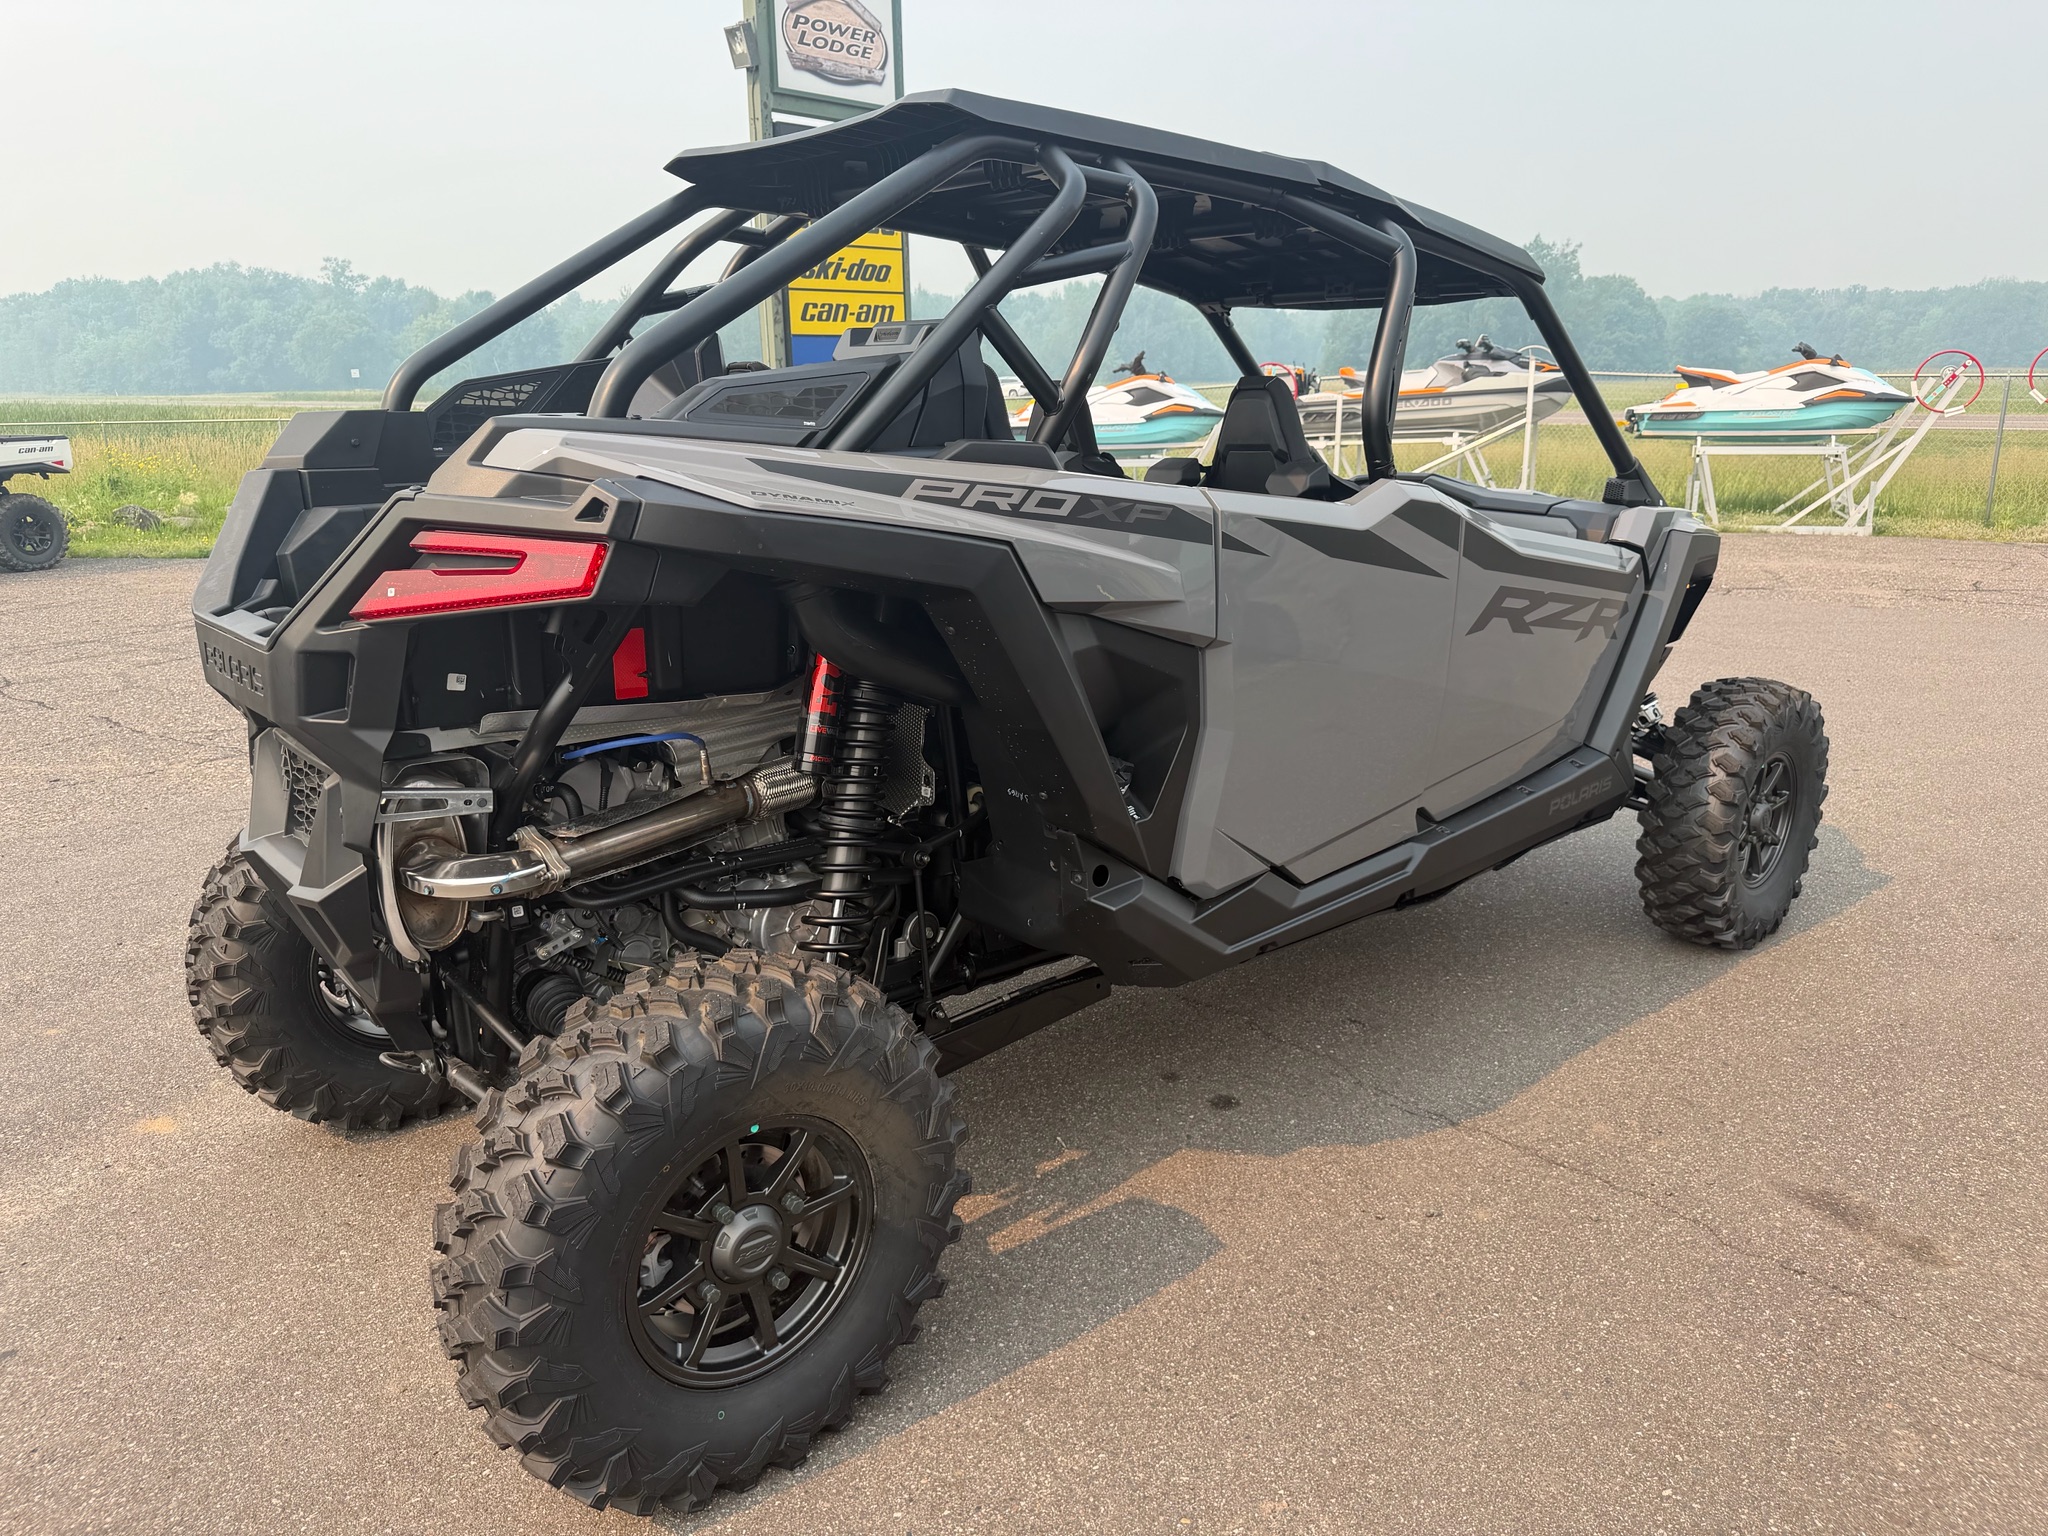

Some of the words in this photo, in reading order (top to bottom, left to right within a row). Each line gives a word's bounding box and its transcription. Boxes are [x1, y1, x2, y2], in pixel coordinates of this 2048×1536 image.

[792, 14, 876, 44] POWER
[797, 30, 873, 60] LODGE
[801, 302, 895, 323] can-am
[18, 446, 53, 454] can-am
[750, 491, 855, 506] DYNAMIX
[900, 478, 1081, 517] PRO
[1076, 499, 1173, 523] XP
[1464, 585, 1629, 643] RZR
[204, 642, 264, 696] POLARIS
[1549, 776, 1614, 816] POLARIS
